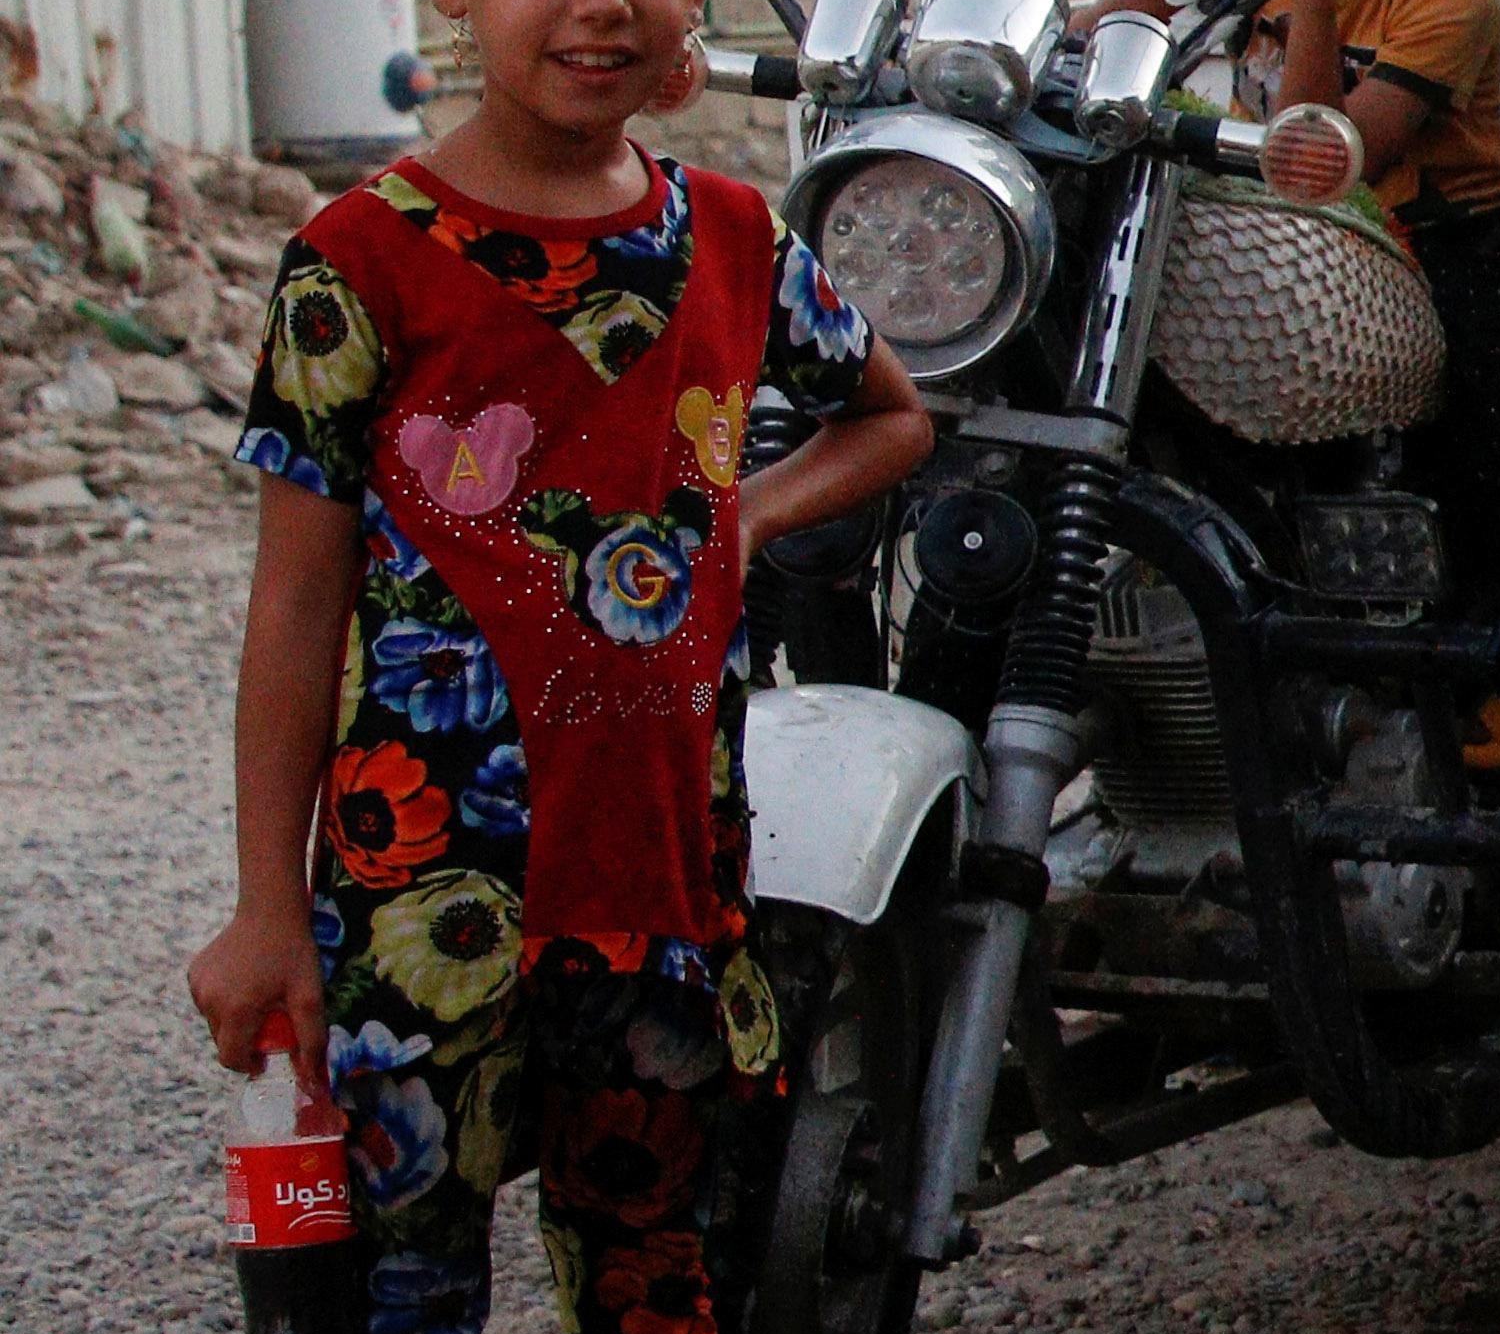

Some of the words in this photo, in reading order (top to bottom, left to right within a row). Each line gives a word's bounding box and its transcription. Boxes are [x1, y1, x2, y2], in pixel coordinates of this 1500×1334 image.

[447, 434, 486, 492] A
[607, 542, 666, 610] G
[275, 1179, 333, 1210] كولا
